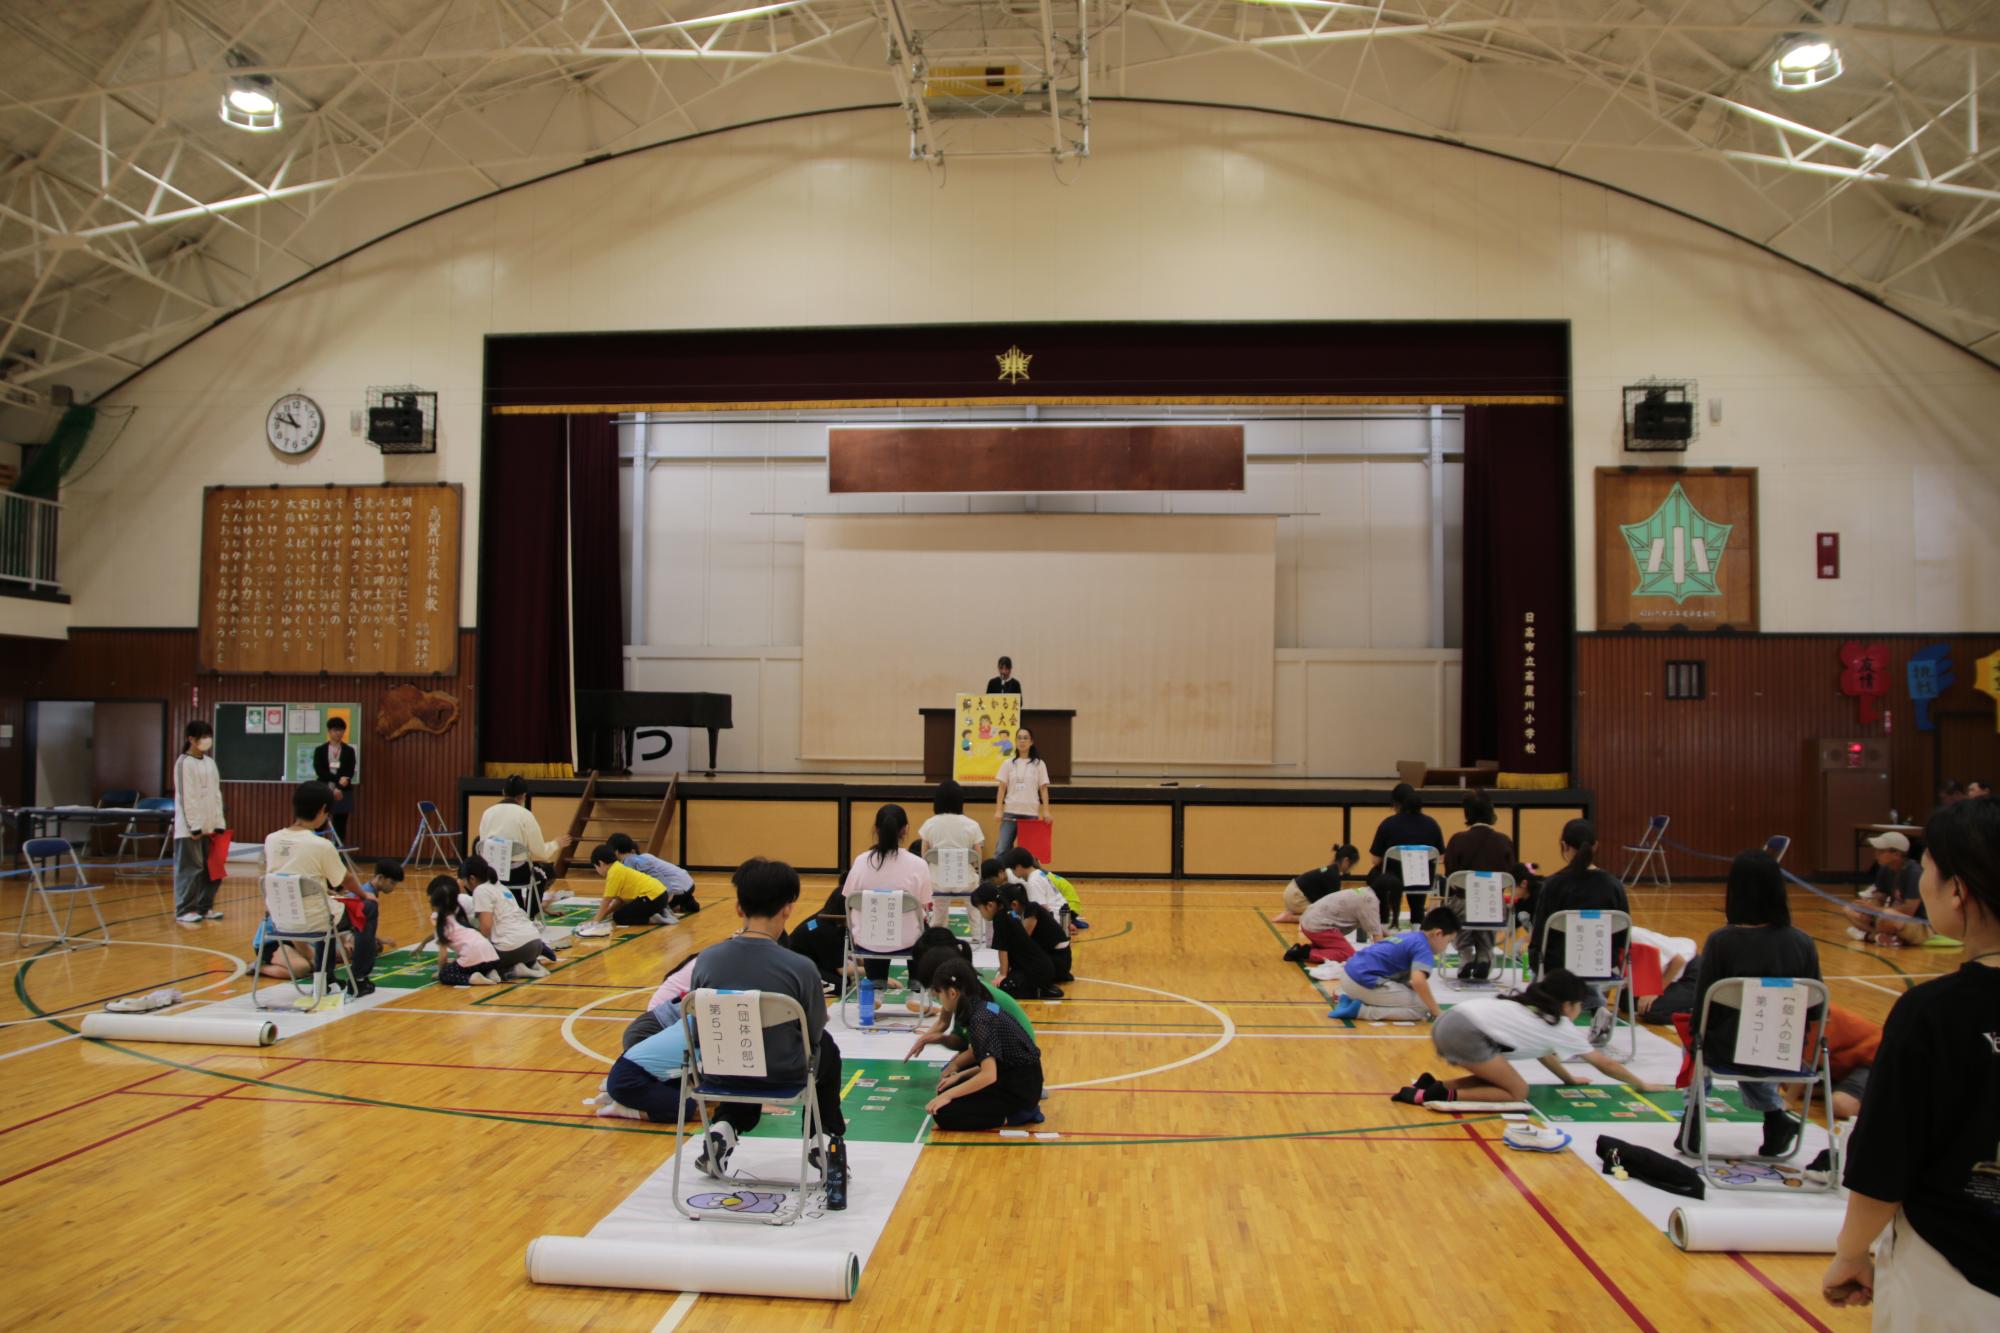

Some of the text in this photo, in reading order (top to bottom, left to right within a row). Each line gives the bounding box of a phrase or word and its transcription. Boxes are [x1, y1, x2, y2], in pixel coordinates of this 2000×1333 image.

[292, 401, 300, 409] 12
[1524, 611, 1536, 754] 日高市立高麗川小学校
[709, 1003, 725, 1065] 第5コート
[1751, 995, 1767, 1056] 第4コート
